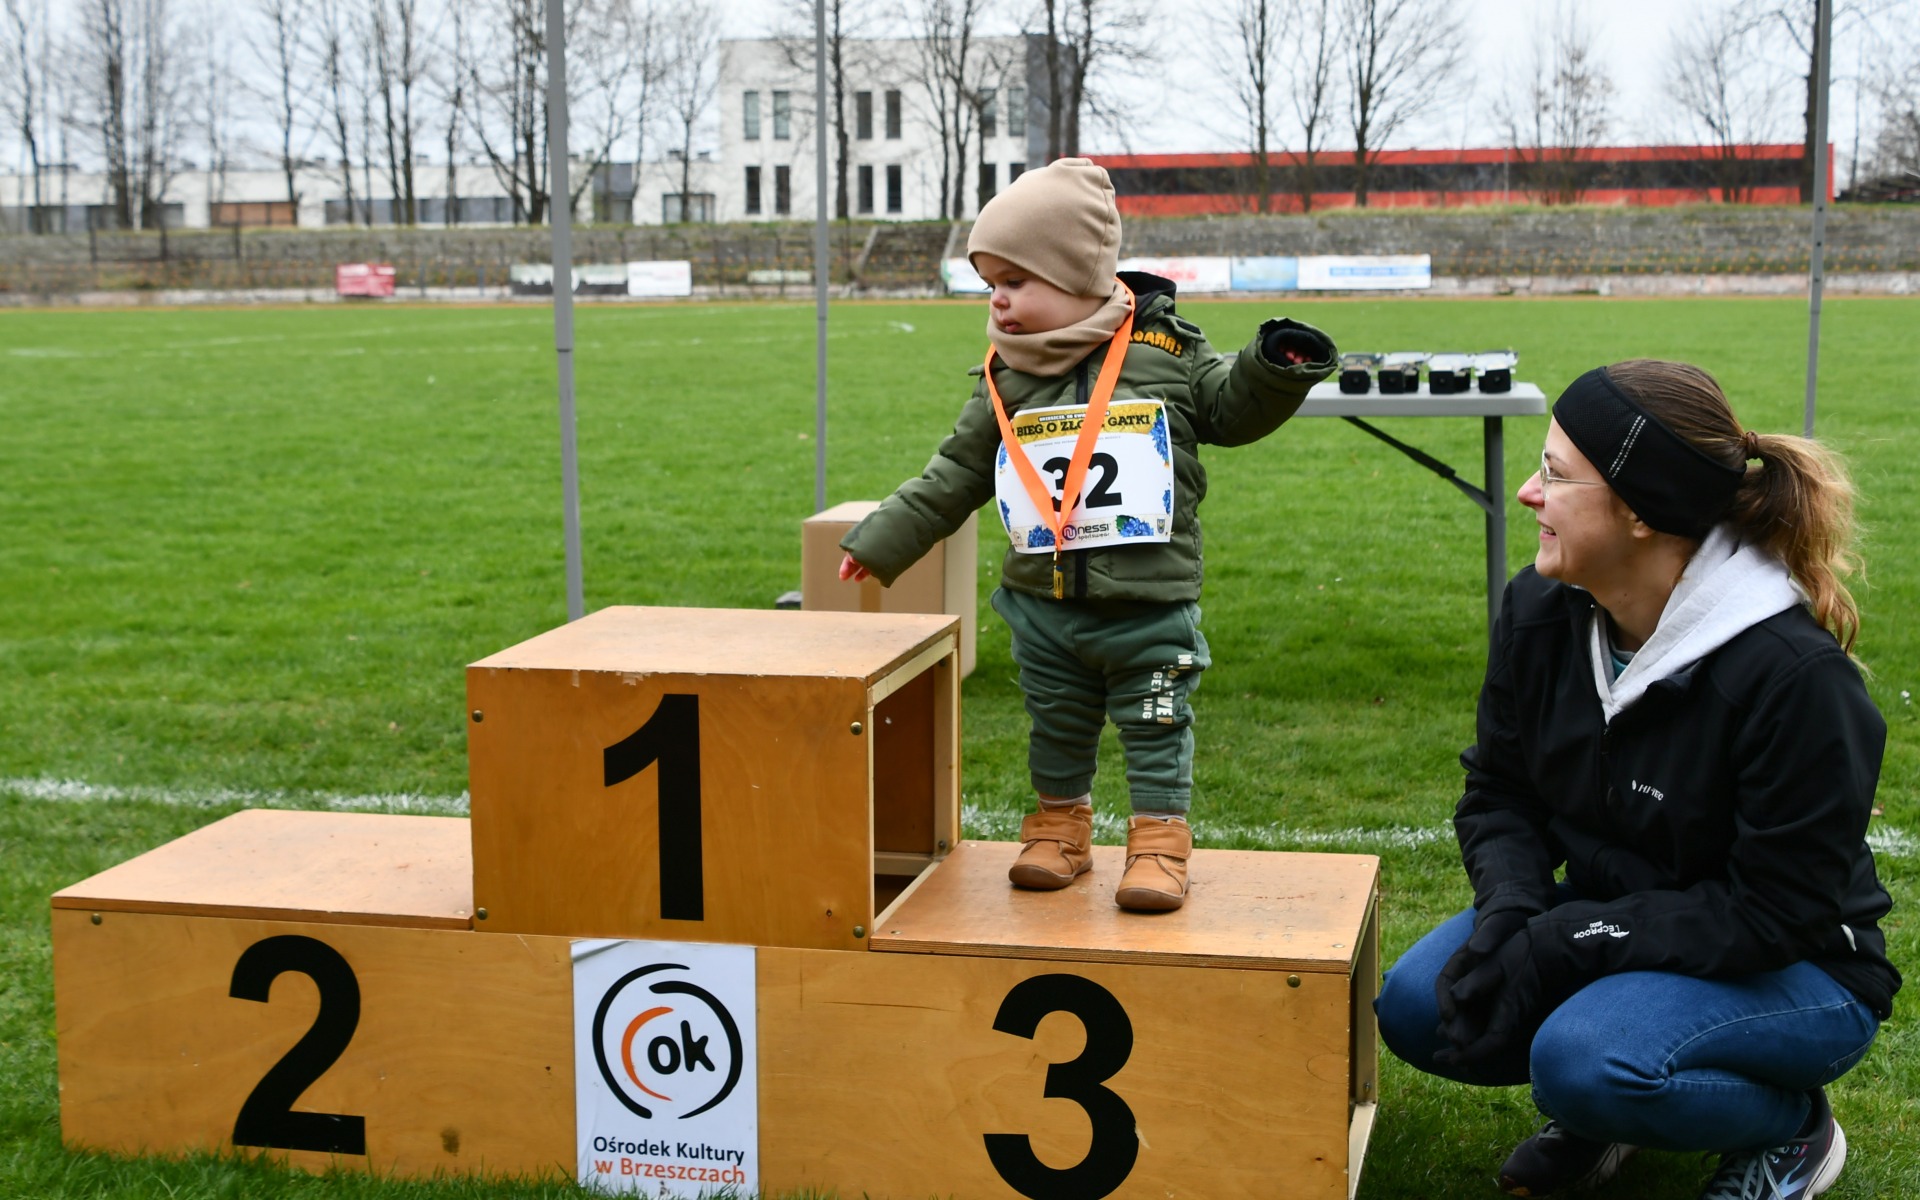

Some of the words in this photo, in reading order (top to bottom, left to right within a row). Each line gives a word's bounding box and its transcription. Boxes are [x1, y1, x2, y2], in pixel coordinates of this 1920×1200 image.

[1016, 423, 1044, 437] BIEG
[1047, 421, 1057, 433] O
[1107, 414, 1151, 427] GATKI
[1042, 452, 1122, 513] 32
[604, 694, 704, 921] 1
[230, 935, 365, 1155] 2
[984, 973, 1139, 1200] 3
[593, 1136, 671, 1158] Ośrodek
[676, 1142, 745, 1166] Kultury
[595, 1159, 613, 1174] w
[620, 1157, 745, 1184] Brzeszczach
